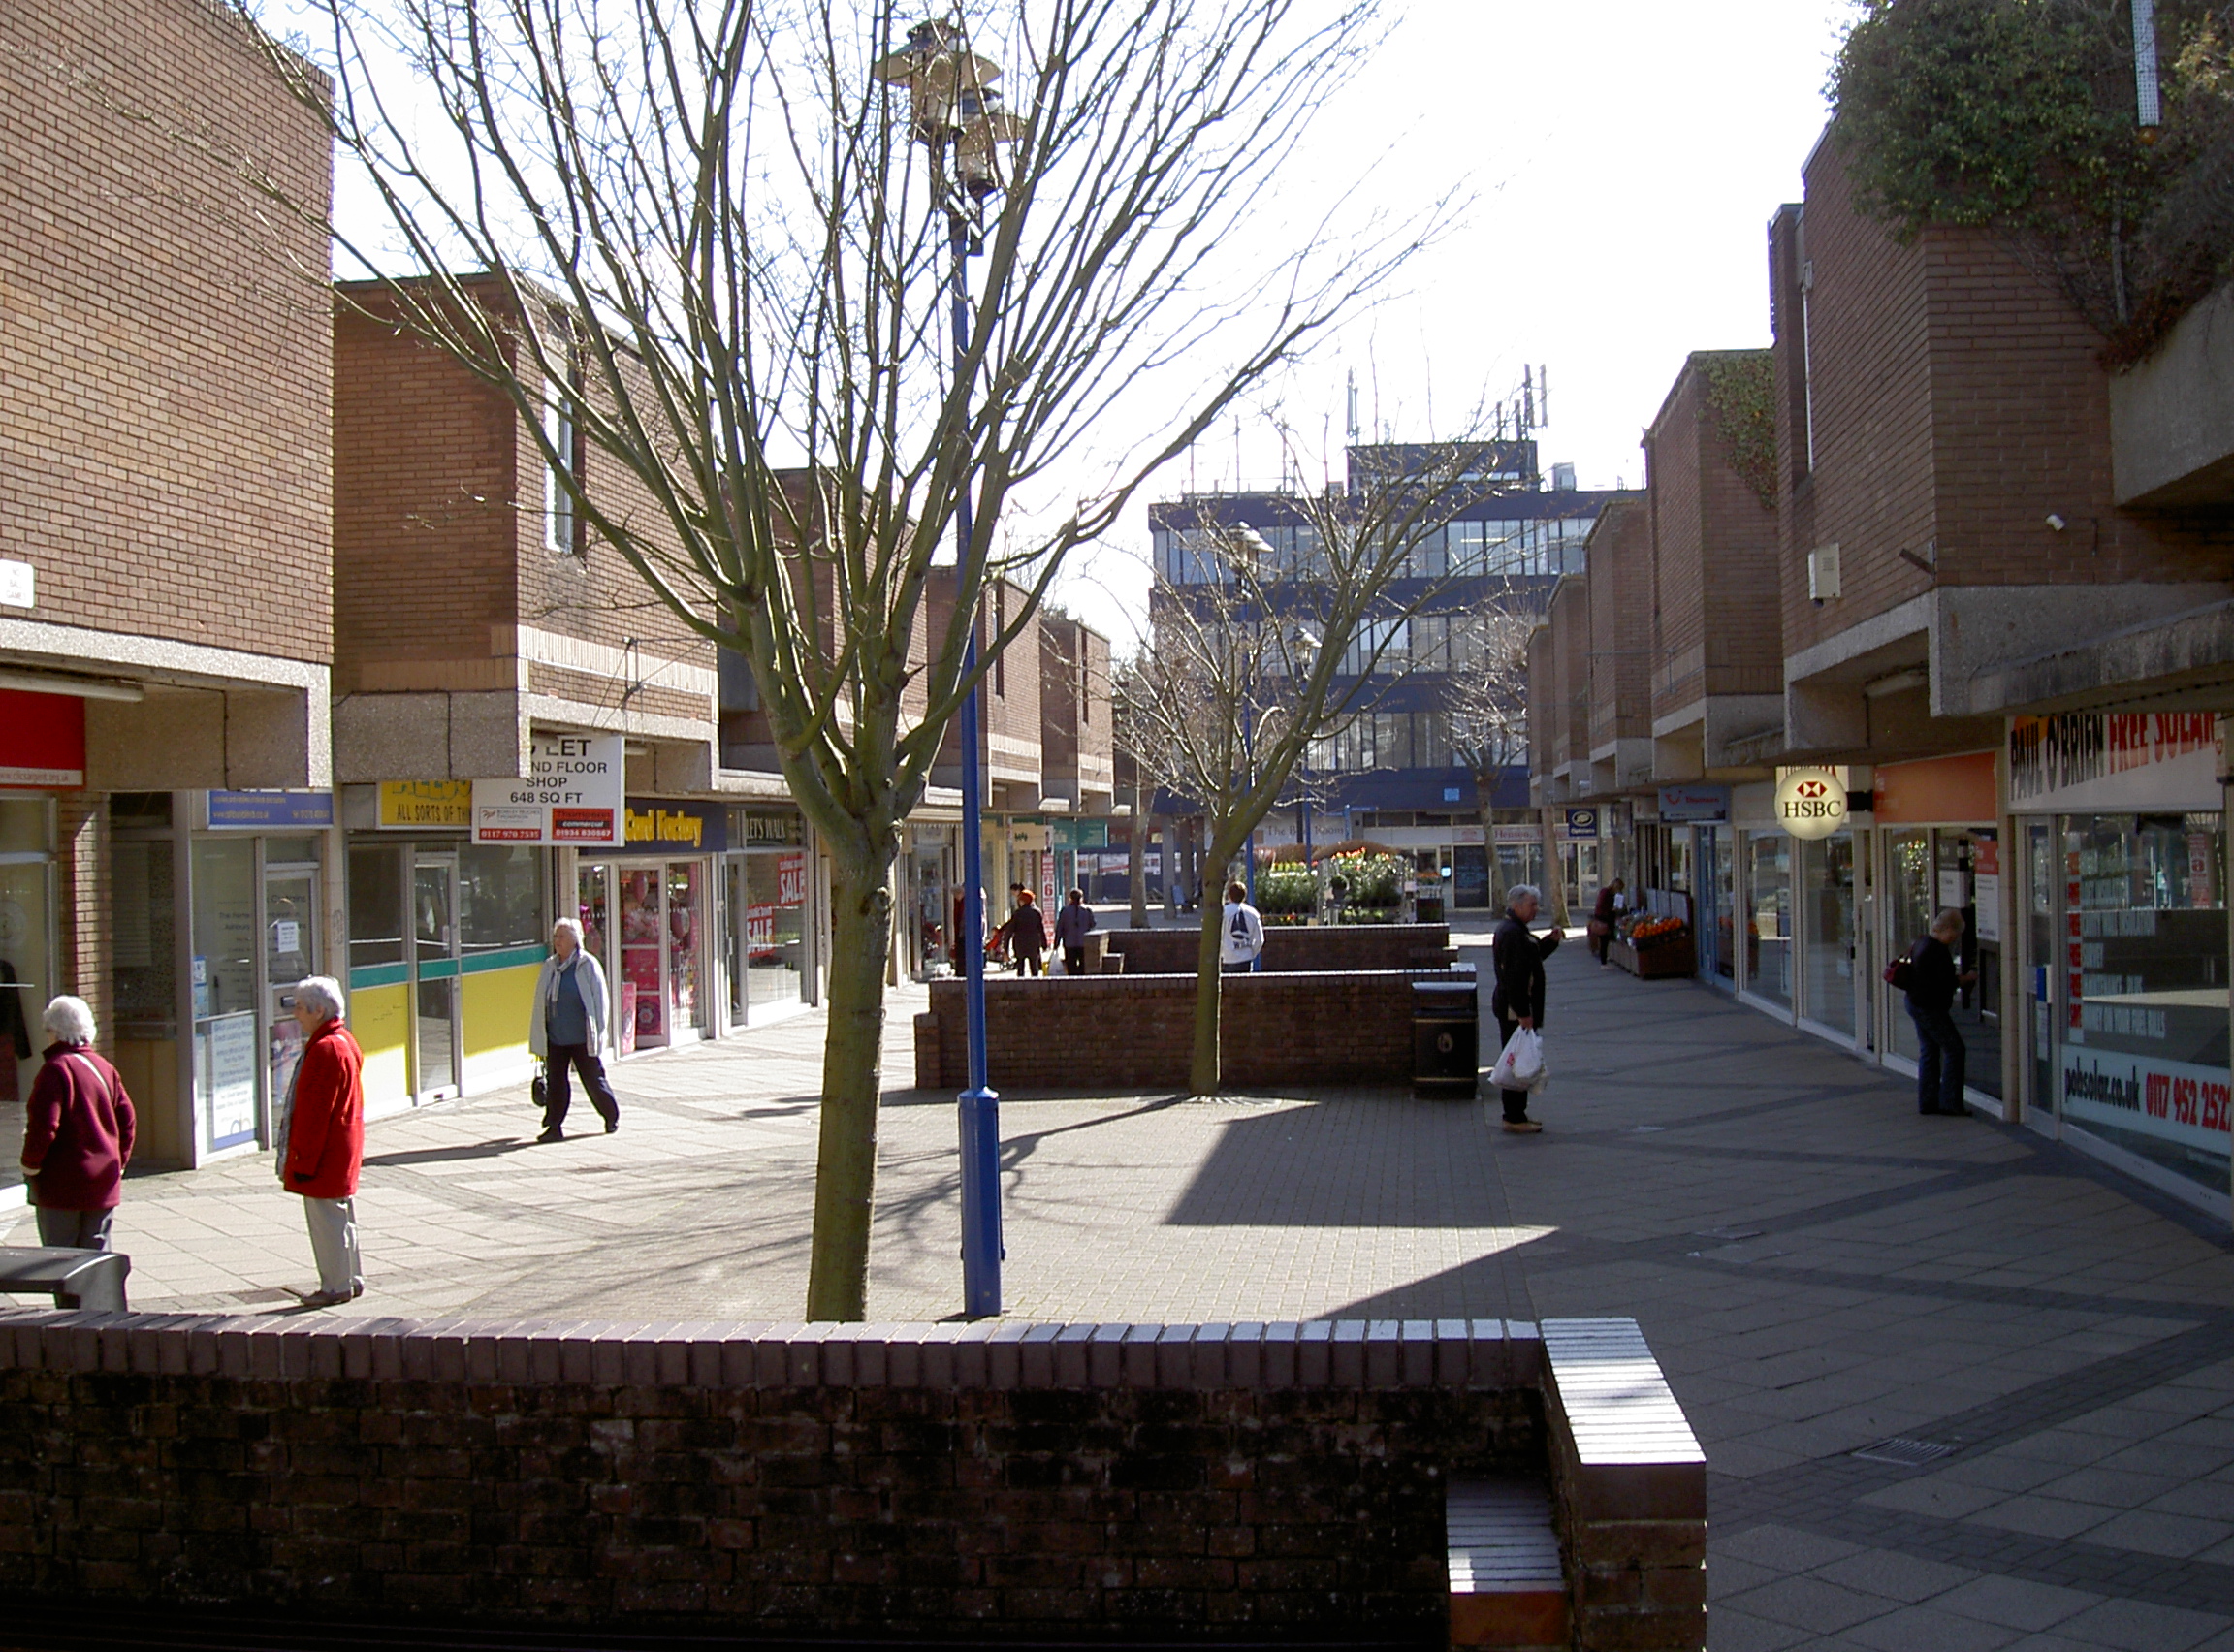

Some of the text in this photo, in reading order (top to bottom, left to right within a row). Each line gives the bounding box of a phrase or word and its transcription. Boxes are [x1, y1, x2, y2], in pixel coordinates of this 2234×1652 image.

[545, 738, 592, 757] LET
[2010, 721, 2043, 803] PAUL
[2046, 713, 2105, 794] O'BRIEN
[2109, 713, 2150, 775] FREE
[557, 762, 608, 774] FLOOR
[526, 776, 568, 788] SHOP
[510, 792, 583, 805] 648 SQ FT
[397, 803, 411, 821] ALL
[415, 804, 441, 822] SORTS
[444, 805, 453, 822] OF
[1783, 800, 1842, 819] HSBC
[481, 831, 501, 840] 0117
[625, 808, 703, 848] Card Factory
[747, 817, 764, 839] LET'S
[765, 818, 786, 839] WALK
[781, 871, 805, 904] SALE
[747, 918, 773, 954] SALE
[2146, 1072, 2171, 1119] 0117
[2174, 1076, 2197, 1126] 952
